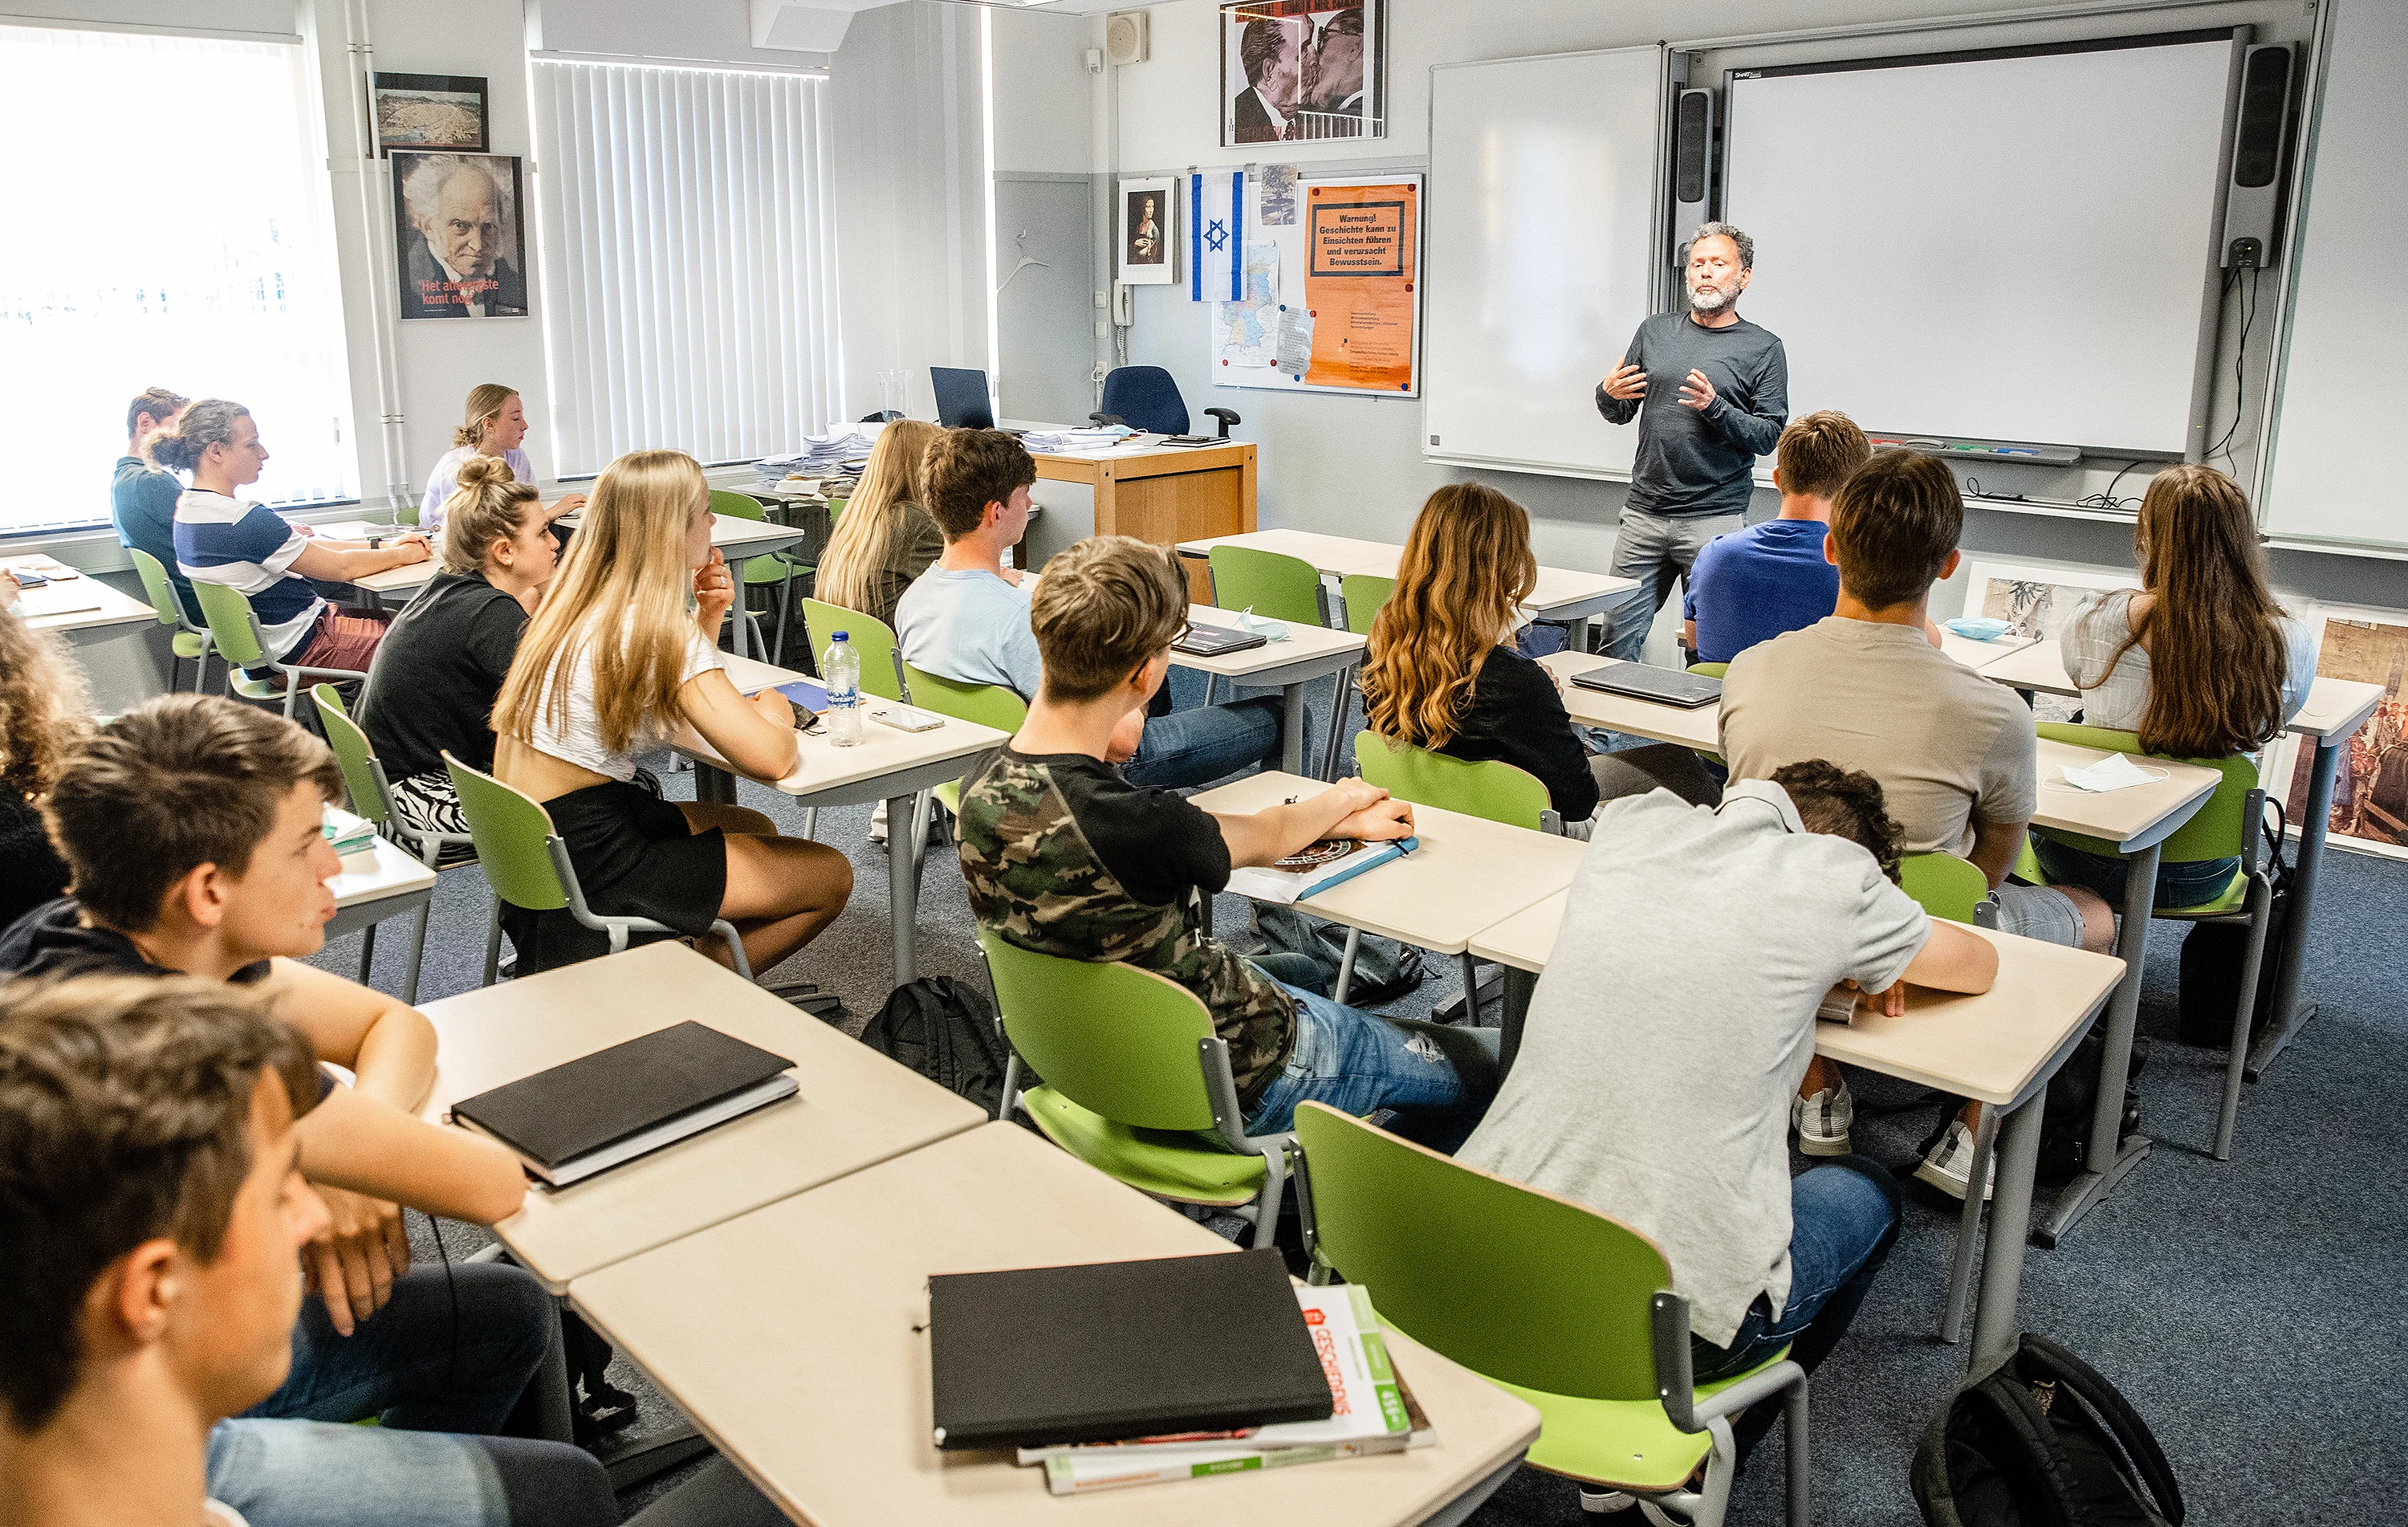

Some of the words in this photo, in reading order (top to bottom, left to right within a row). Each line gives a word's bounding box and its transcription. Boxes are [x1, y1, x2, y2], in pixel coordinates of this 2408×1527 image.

[1340, 214, 1377, 223] Warnung!
[1319, 226, 1363, 234] Geschichte
[1365, 225, 1385, 233] kann
[1323, 236, 1364, 244] Einsichten
[1366, 235, 1392, 243] führen
[1327, 247, 1341, 255] und
[1344, 246, 1386, 254] verursacht
[1329, 258, 1382, 266] Bewusstsein.
[421, 292, 449, 305] komt
[1314, 1329, 1352, 1416] GESCHIEDENIS
